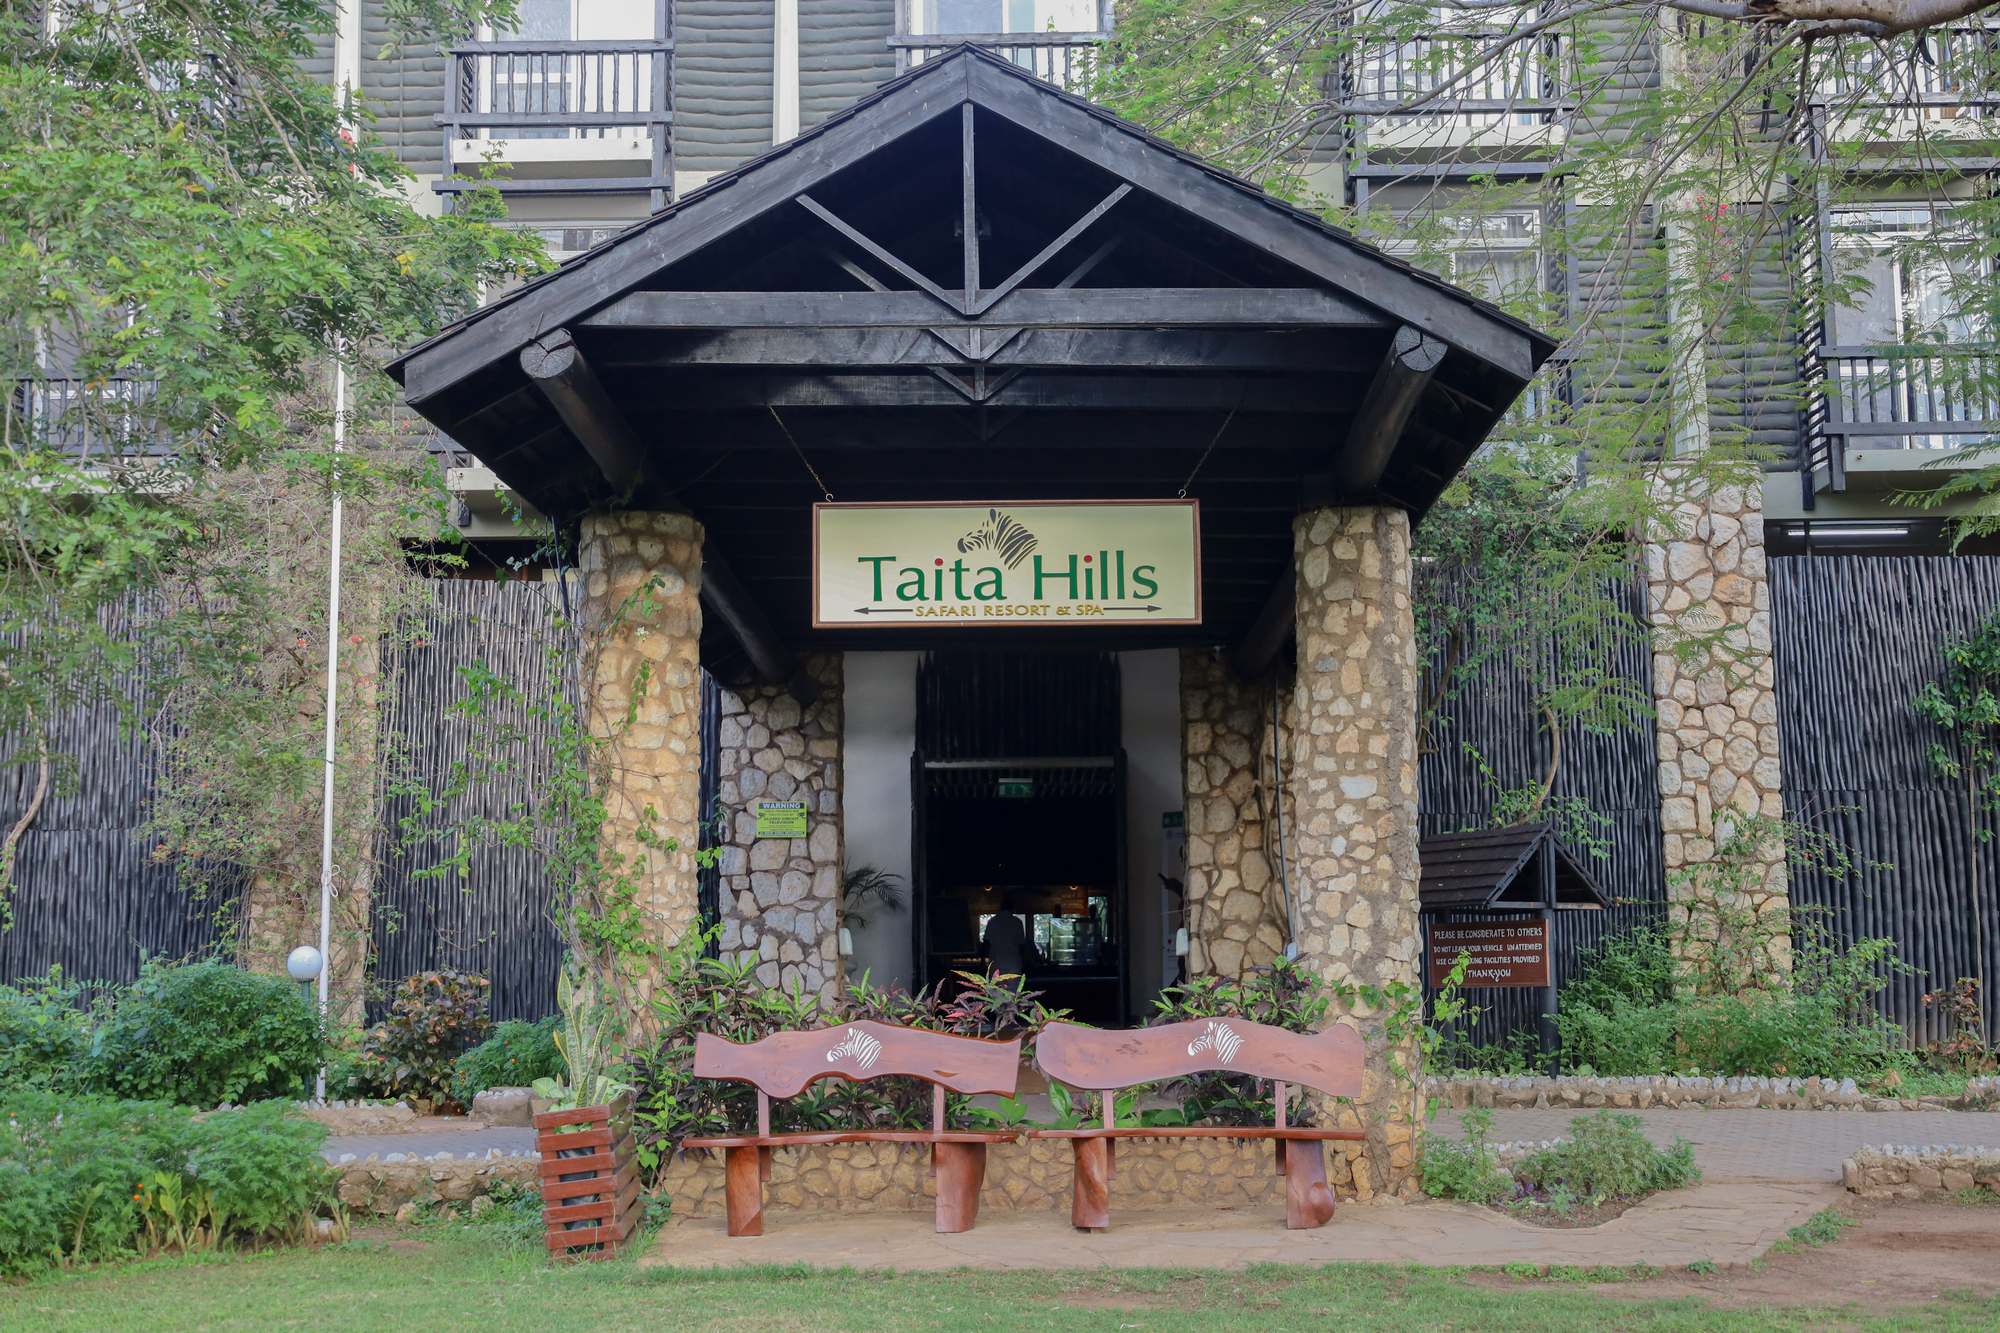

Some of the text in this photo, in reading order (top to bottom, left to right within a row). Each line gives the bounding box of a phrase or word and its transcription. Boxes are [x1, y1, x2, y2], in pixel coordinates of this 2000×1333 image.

[857, 550, 1158, 602] Taita Hills
[915, 603, 1104, 616] SAFARI RESORT & SPA
[1434, 927, 1543, 940] PLEASE BE CONSIDERATE TO OTHERS
[1507, 943, 1543, 951] UNATTENDED
[1483, 956, 1511, 964] FACILITIES
[1512, 955, 1541, 963] PROVIDED
